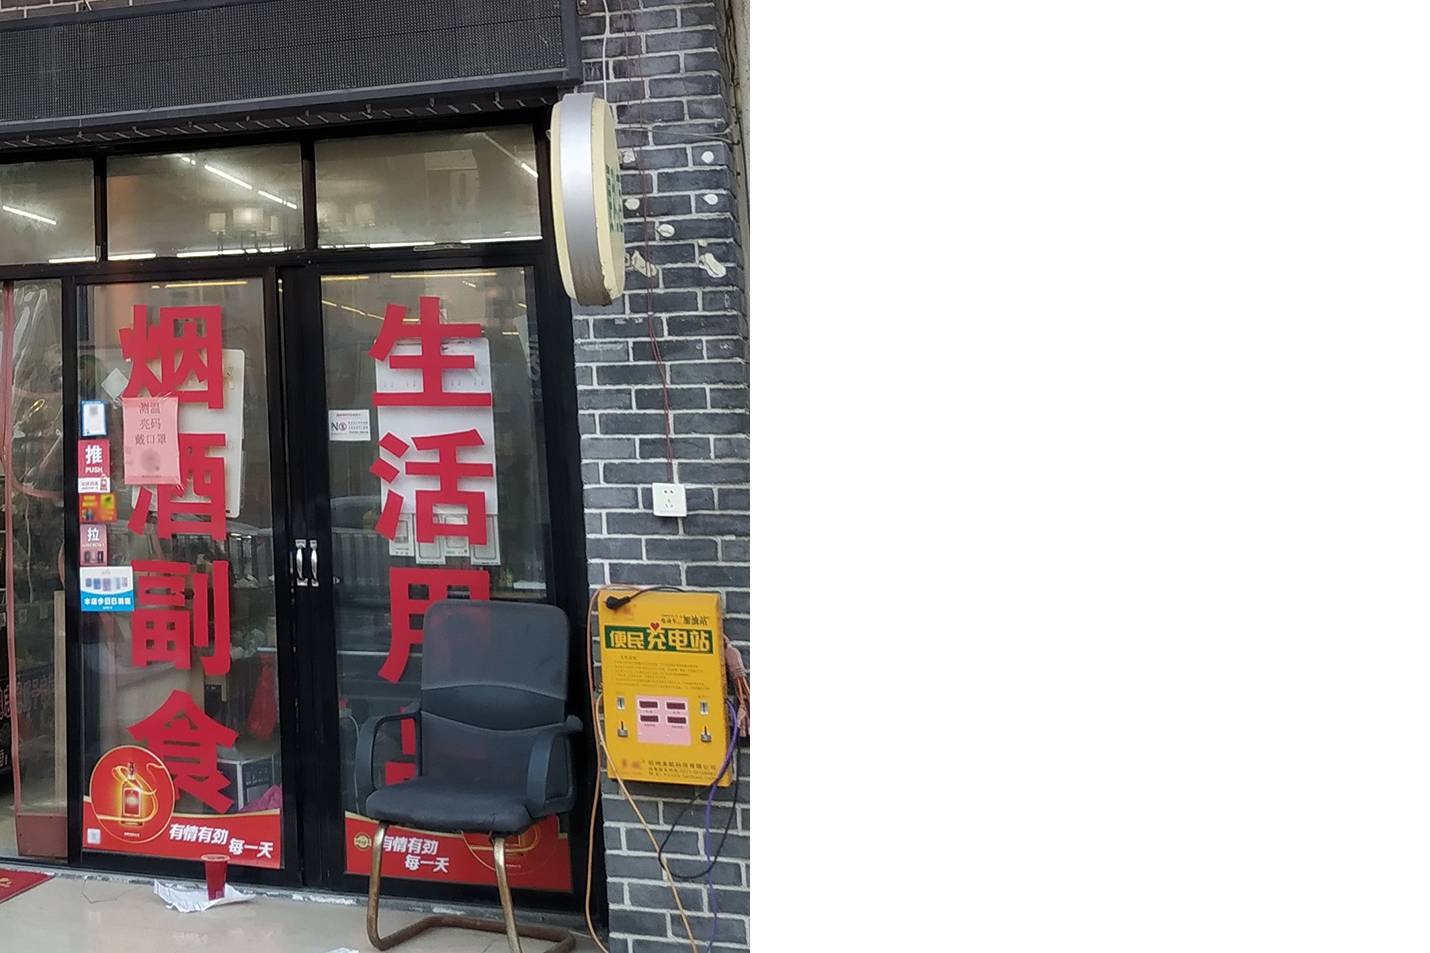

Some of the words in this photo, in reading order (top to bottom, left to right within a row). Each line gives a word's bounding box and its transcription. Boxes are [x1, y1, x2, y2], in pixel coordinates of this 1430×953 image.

[139, 402, 161, 414] 测温
[140, 418, 161, 430] 亮码
[135, 434, 167, 445] 戴口罩
[85, 445, 103, 464] 推
[85, 466, 103, 474] PUSH
[87, 527, 100, 542] 拉
[369, 297, 494, 786] 生活用
[119, 304, 238, 814] 烟酒副食
[609, 628, 710, 652] 便民充电站
[169, 823, 229, 845] 有情有劲
[228, 837, 274, 859] 每一天
[404, 855, 449, 873] 每一天
